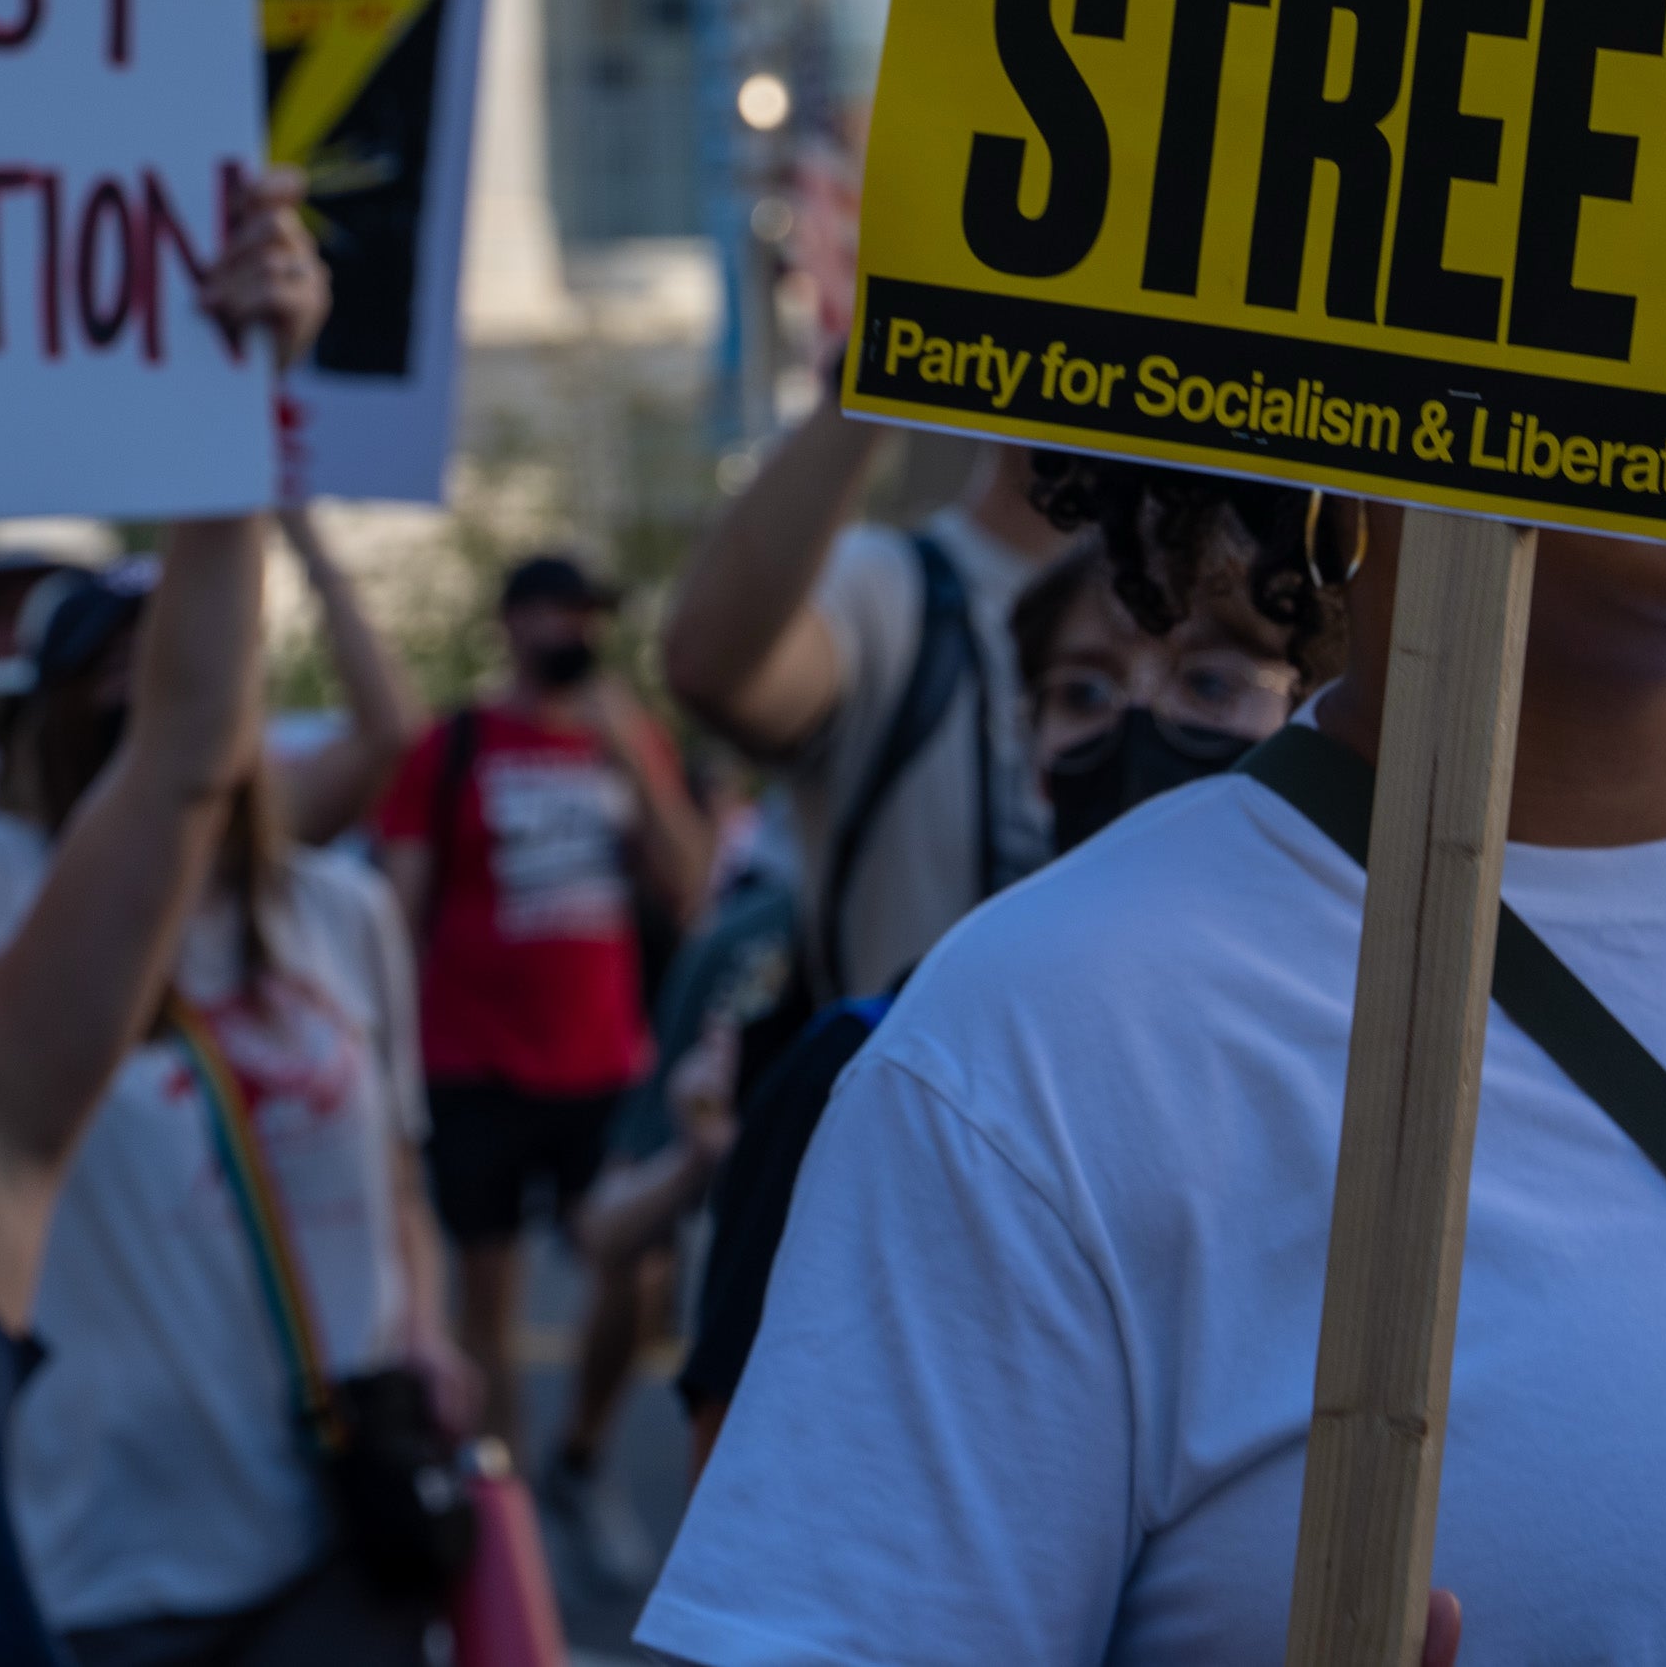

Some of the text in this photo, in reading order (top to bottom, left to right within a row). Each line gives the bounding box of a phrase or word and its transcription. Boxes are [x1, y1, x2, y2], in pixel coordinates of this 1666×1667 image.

[884, 317, 1030, 408] Party
[1040, 341, 1126, 408] for
[1134, 355, 1399, 454] Socialism
[1411, 400, 1455, 463] &
